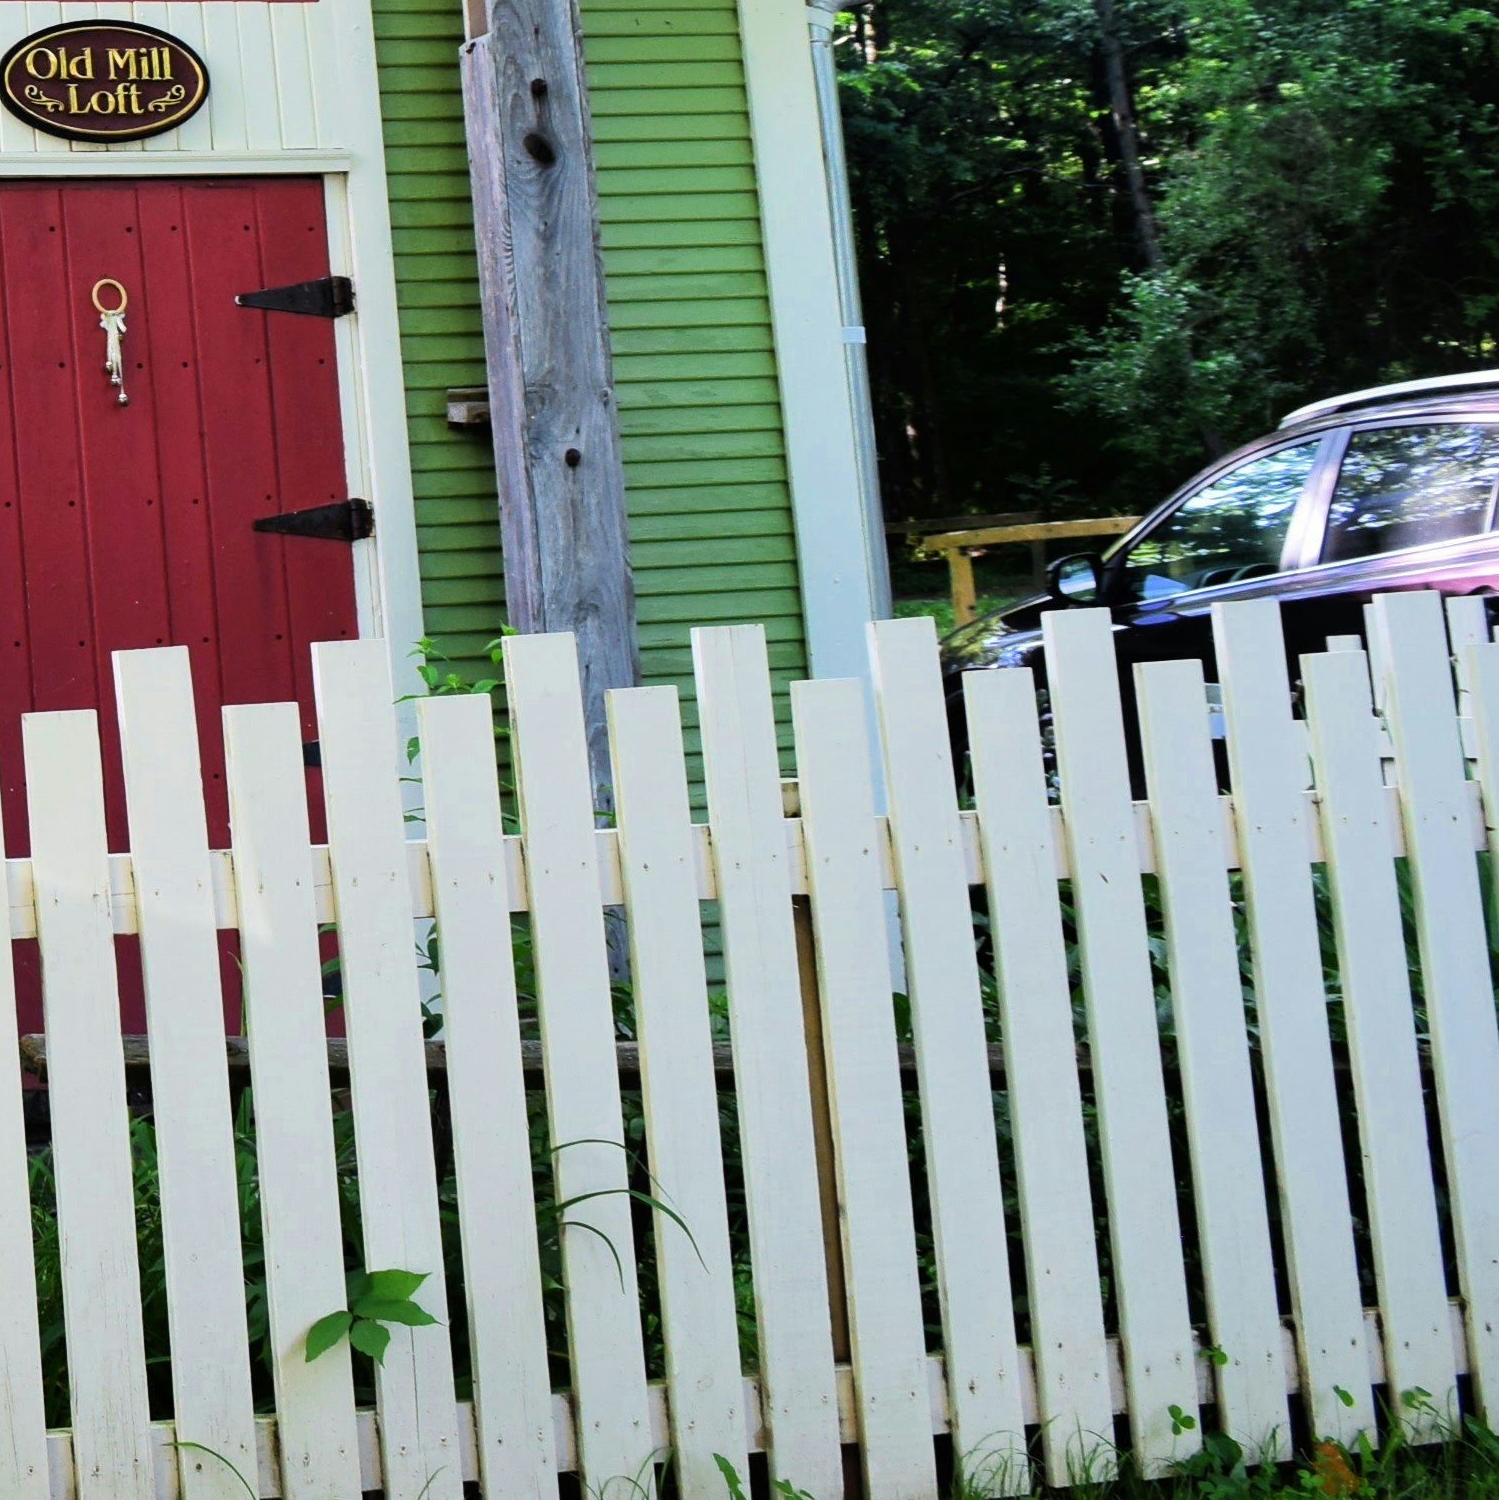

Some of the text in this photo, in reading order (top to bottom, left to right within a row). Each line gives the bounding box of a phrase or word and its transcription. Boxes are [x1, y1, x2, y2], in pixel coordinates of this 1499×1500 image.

[25, 46, 174, 81] Old Mill
[65, 82, 145, 115] Loft
